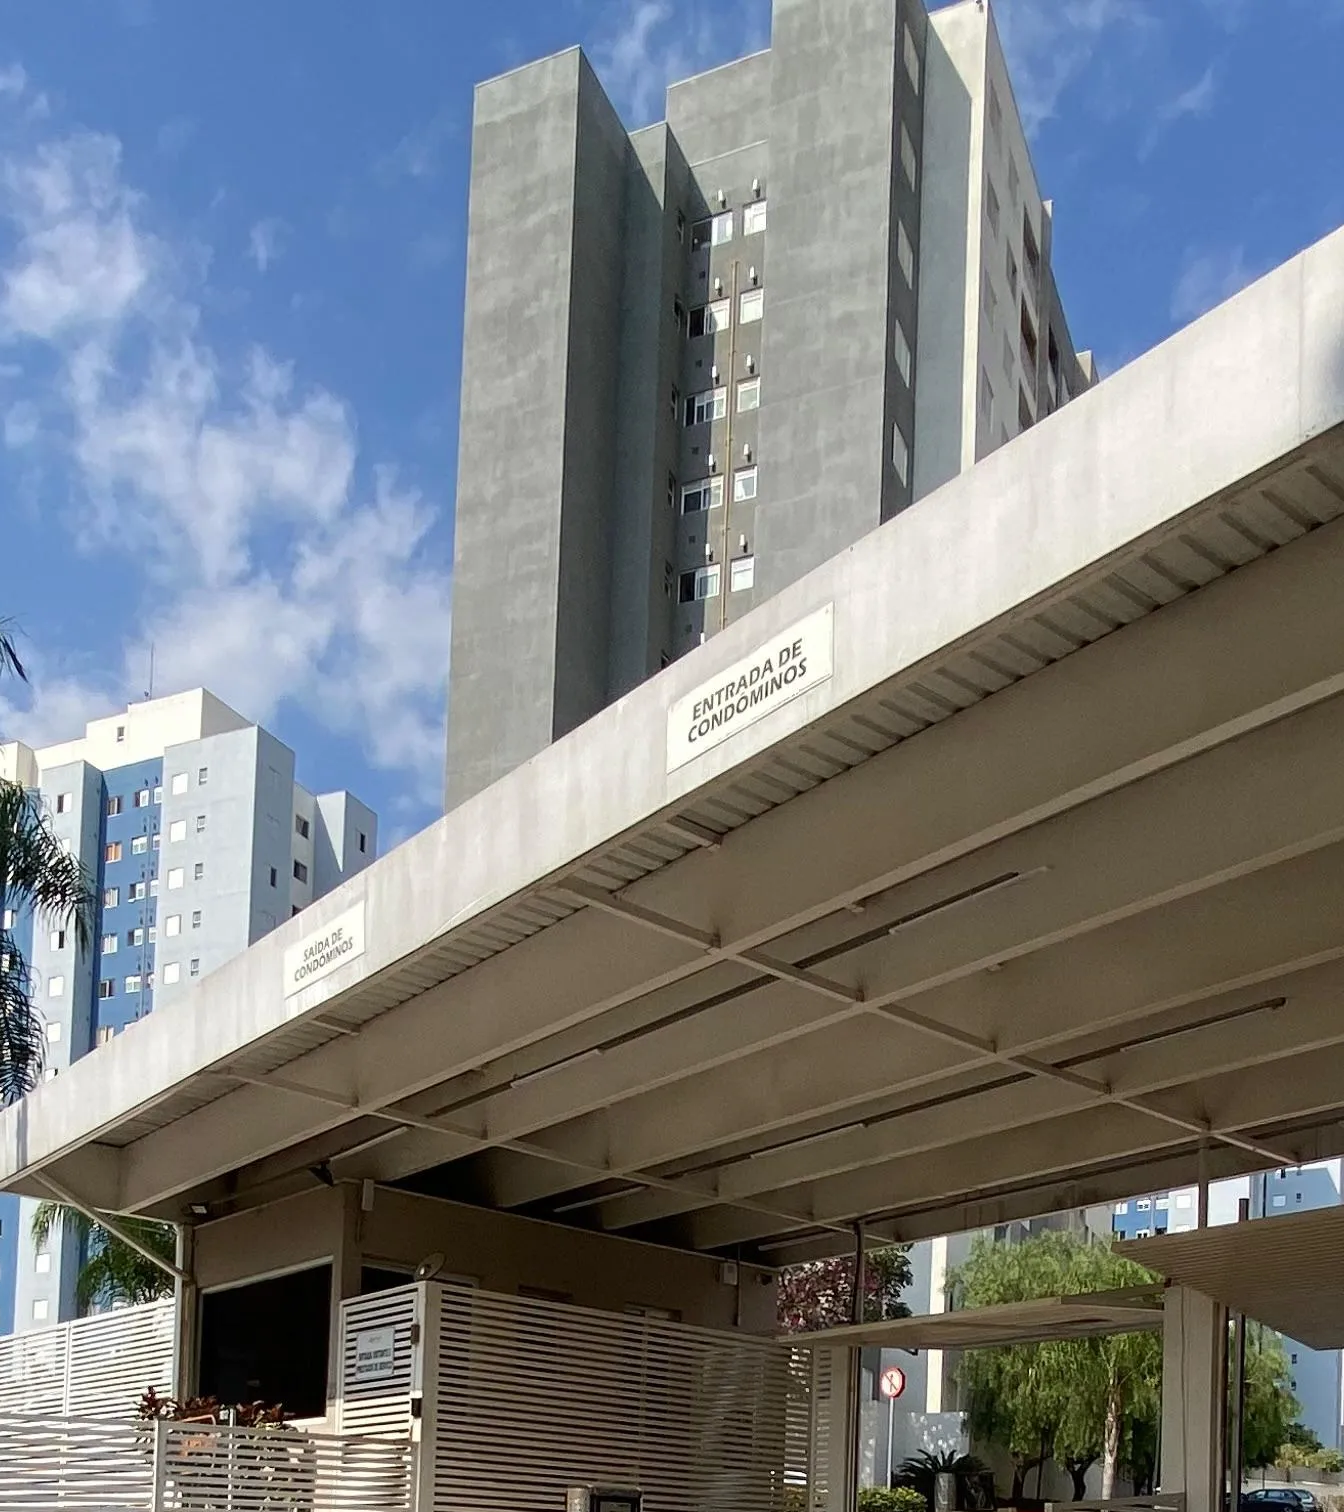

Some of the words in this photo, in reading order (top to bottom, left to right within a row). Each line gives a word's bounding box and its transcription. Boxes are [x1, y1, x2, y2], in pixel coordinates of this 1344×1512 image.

[692, 657, 774, 721] ENTRADA
[778, 637, 803, 668] DE
[331, 927, 343, 945] DE
